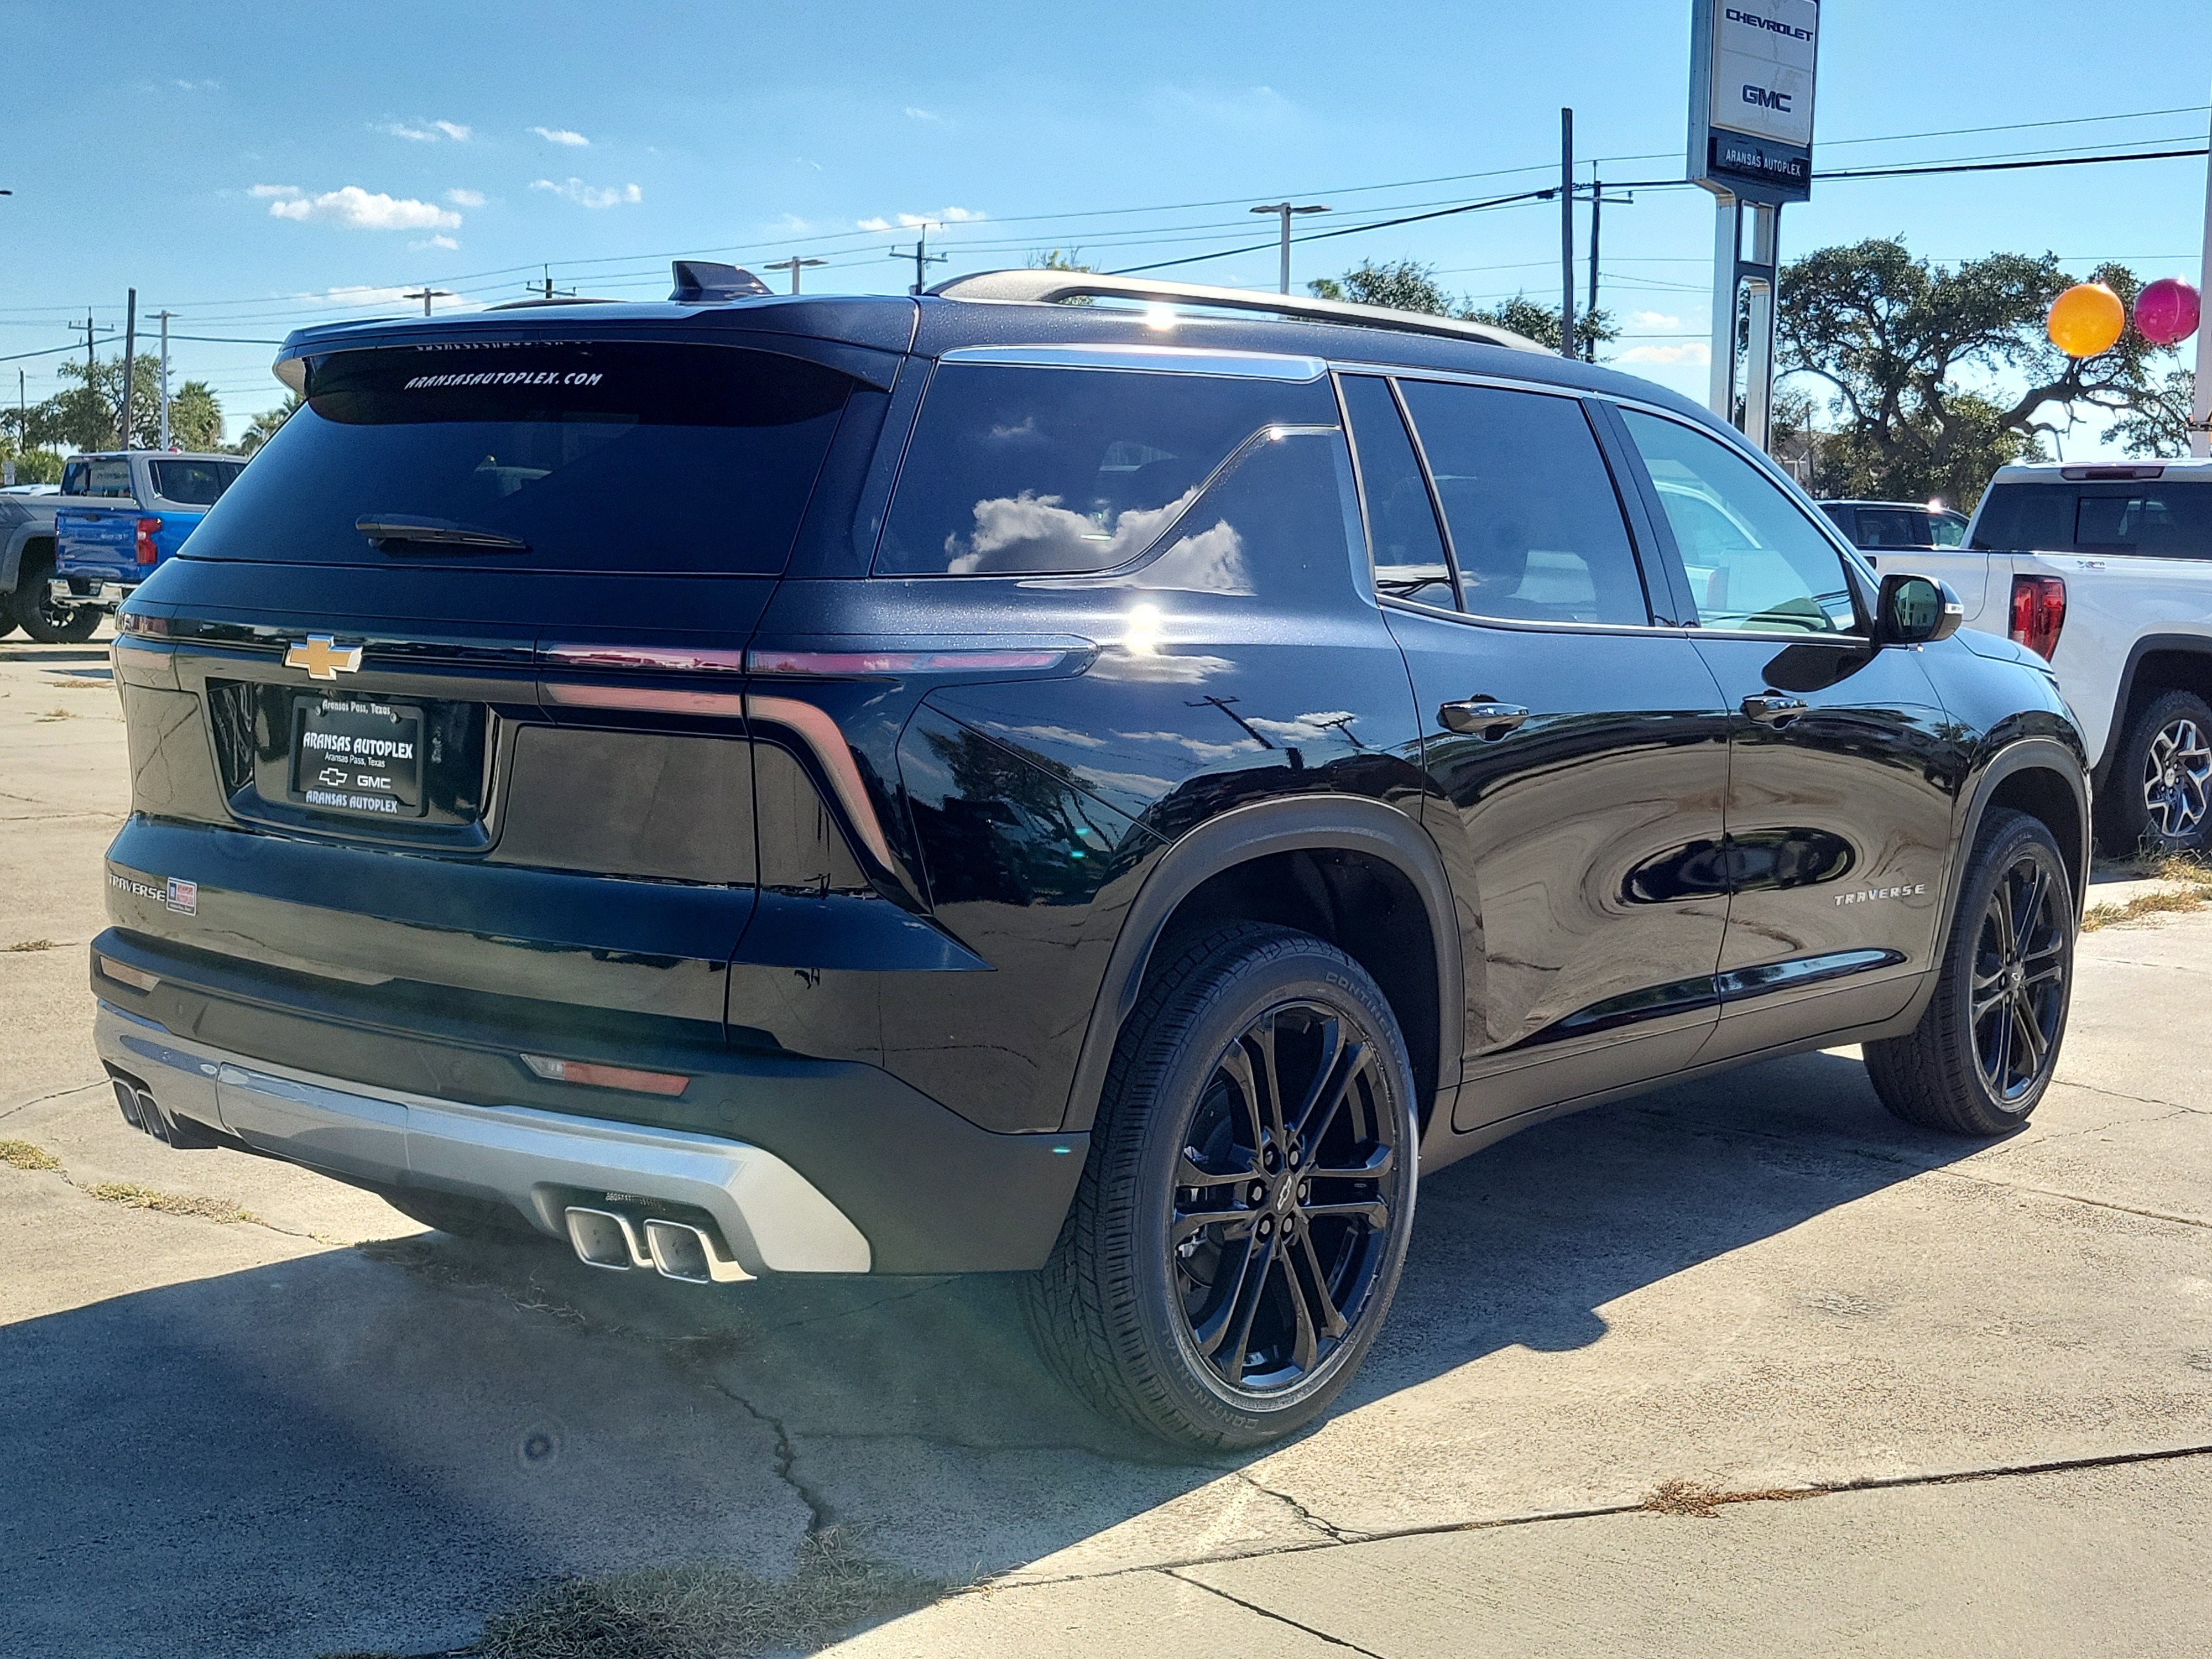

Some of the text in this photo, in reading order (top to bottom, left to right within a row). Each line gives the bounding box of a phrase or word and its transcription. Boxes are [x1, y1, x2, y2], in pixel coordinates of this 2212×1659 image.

[1726, 8, 1813, 42] CHEVROLET
[1743, 85, 1792, 113] GMC
[1725, 149, 1801, 177] ARANSAS AUTOPLEX
[322, 700, 390, 716] Aransas Pass, Texas
[303, 732, 351, 752] ARANSAS
[353, 737, 413, 760] AUTOPLEX
[325, 752, 385, 768] Aransas Pass, Texas
[357, 775, 391, 789] GMC
[306, 790, 398, 814] ARANSAS AUTOPLEX
[108, 873, 166, 902] TRAVERSE
[1834, 883, 1926, 906] TRAVERSE
